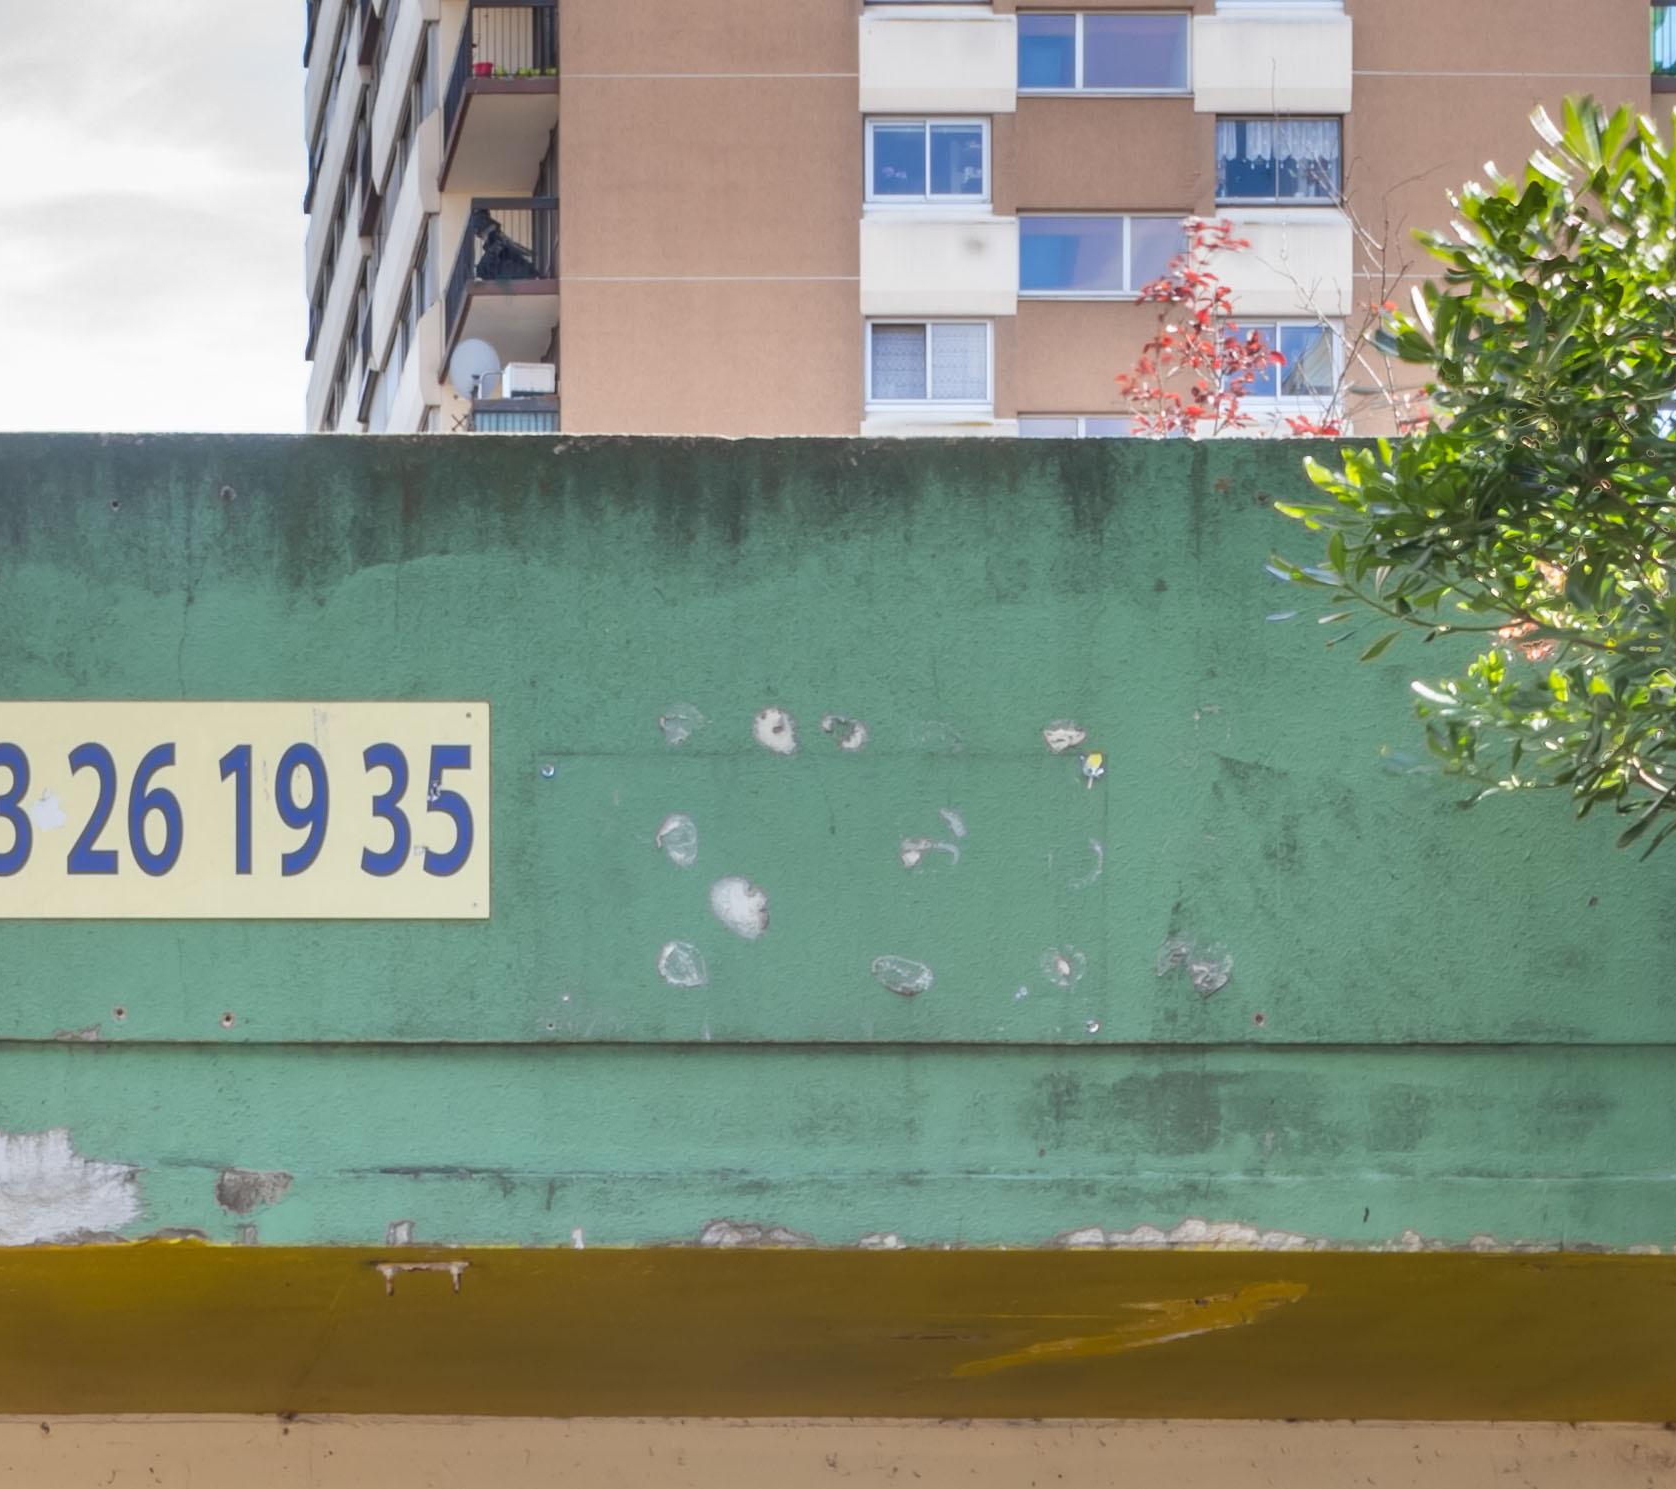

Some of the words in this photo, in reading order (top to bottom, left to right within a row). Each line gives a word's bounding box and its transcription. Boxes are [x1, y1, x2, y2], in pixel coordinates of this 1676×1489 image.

[65, 742, 184, 878] 26
[217, 742, 329, 878] 19
[359, 743, 475, 878] 35
